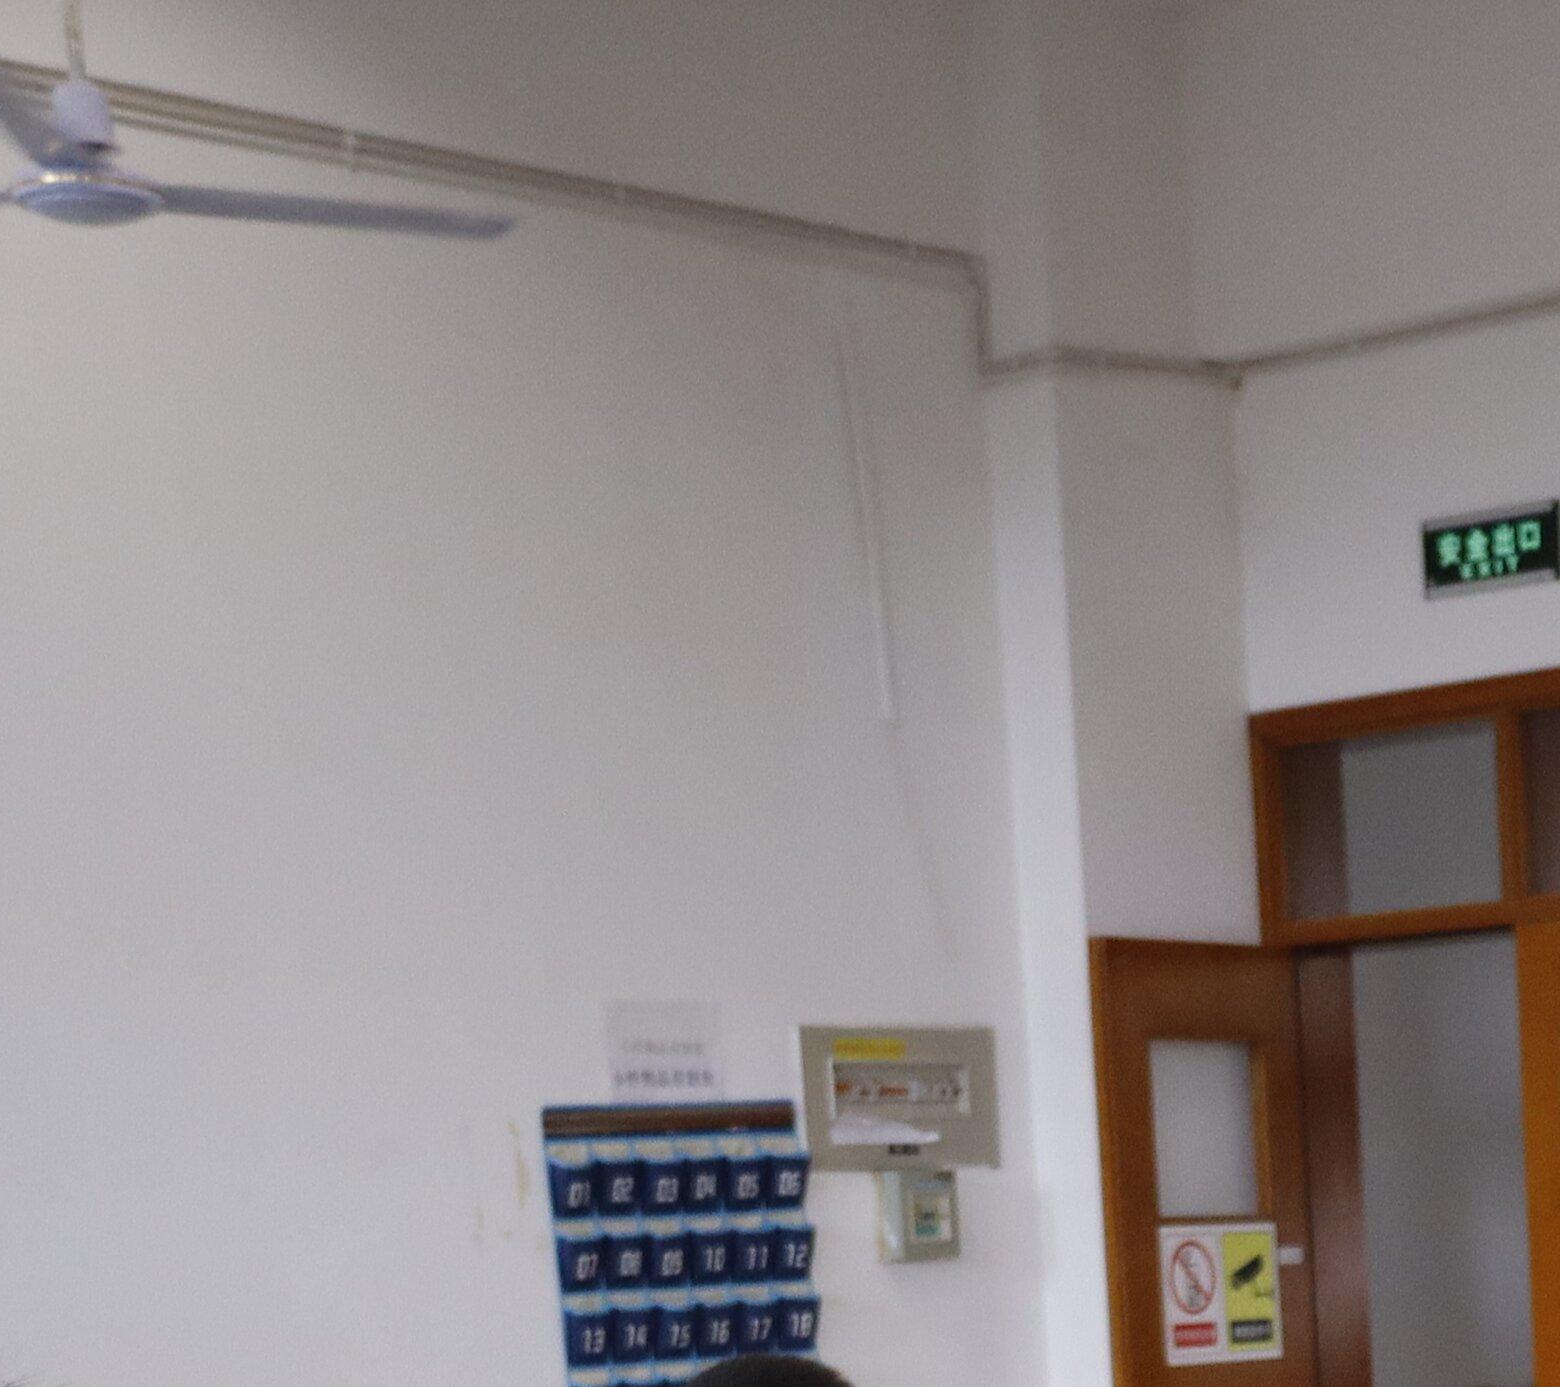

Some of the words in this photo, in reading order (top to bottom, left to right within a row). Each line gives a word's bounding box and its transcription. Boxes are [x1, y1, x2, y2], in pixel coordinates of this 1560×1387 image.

[695, 1174, 716, 1199] 04
[575, 1253, 597, 1280] 07
[704, 1246, 725, 1271] 10
[747, 1245, 768, 1269] 11
[785, 1242, 808, 1268] 12
[582, 1327, 605, 1353] 13
[626, 1324, 646, 1347] 14
[669, 1322, 690, 1347] 15
[710, 1320, 729, 1344] 16
[749, 1317, 771, 1340] 17
